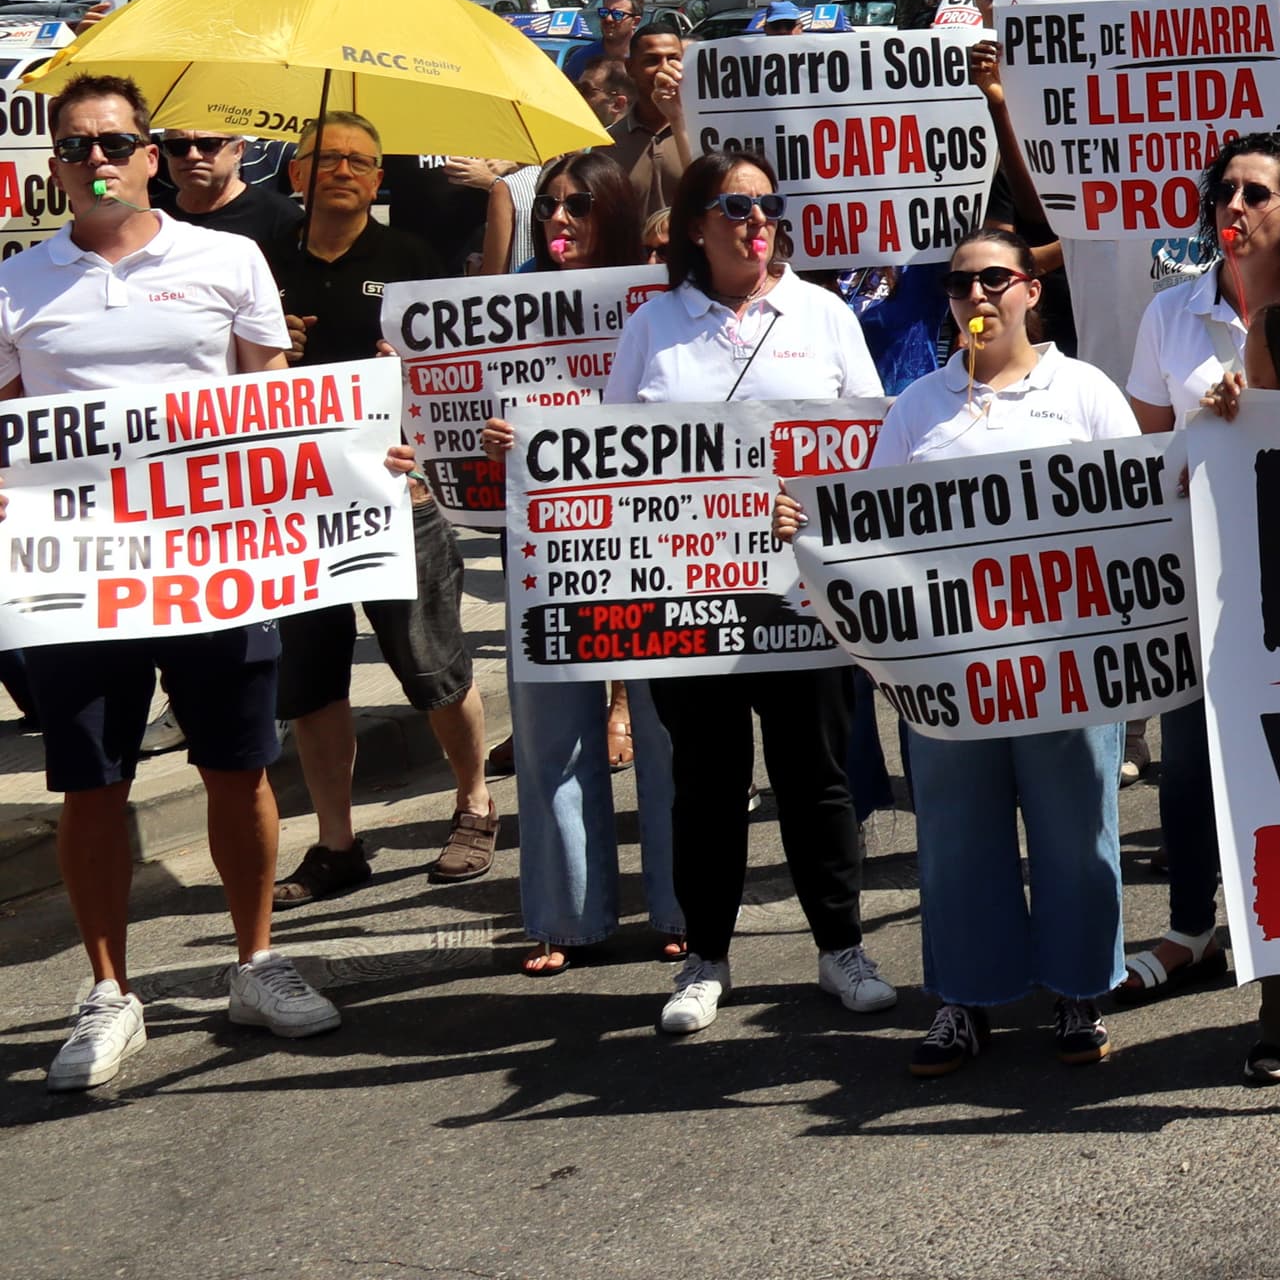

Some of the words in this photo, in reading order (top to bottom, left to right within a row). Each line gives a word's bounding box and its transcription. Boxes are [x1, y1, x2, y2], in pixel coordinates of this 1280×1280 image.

[41, 25, 52, 36] L
[557, 14, 568, 25] L
[819, 7, 829, 19] L
[1005, 14, 1096, 69] PERE,
[1101, 24, 1125, 56] DE
[1131, 4, 1274, 59] NAVARRA
[342, 46, 408, 71] RACC
[413, 57, 462, 73] Mobility
[414, 66, 441, 76] Club
[2, 401, 120, 468] PERE,
[127, 408, 160, 442] DE
[166, 378, 343, 442] NAVARRA
[54, 485, 96, 522] DE
[111, 441, 332, 523] LLEIDA
[816, 474, 1011, 547] Navarro
[1020, 461, 1038, 520] i
[1048, 450, 1164, 517] Soler
[10, 536, 60, 573] NO
[73, 534, 151, 572] TE'N
[166, 509, 307, 568] FOTRÀS
[317, 501, 391, 549] MÉS!
[98, 558, 319, 629] PROu!
[544, 608, 571, 632] EL
[579, 603, 655, 630] "PRO"
[665, 600, 747, 626] PASSA.
[545, 636, 571, 661] EL
[719, 626, 745, 653] ES
[753, 625, 833, 650] QUEDA.
